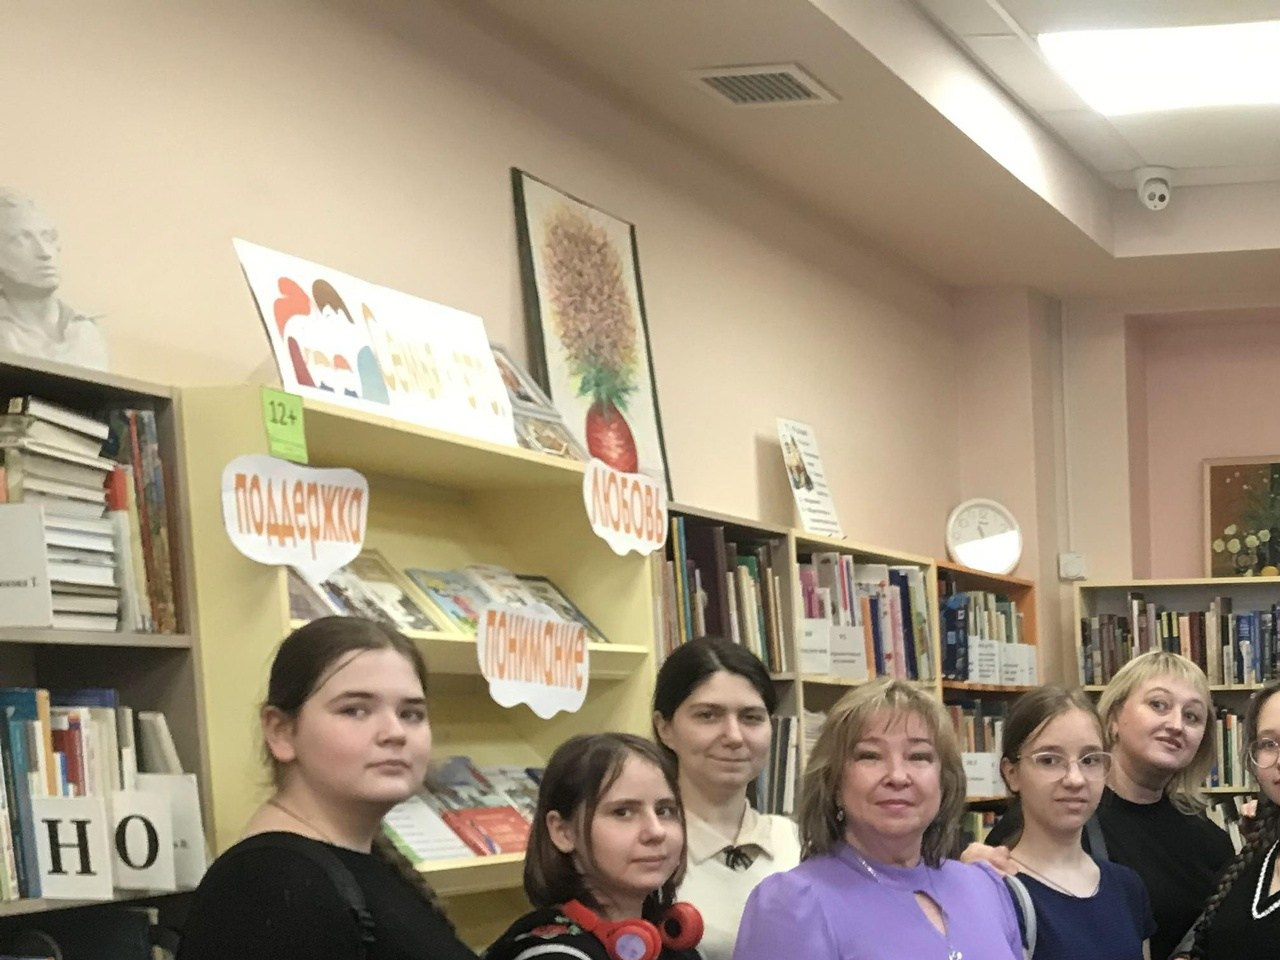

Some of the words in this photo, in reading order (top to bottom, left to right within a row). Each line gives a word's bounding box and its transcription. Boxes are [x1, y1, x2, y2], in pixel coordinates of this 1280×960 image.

[269, 400, 297, 426] 12+
[234, 473, 362, 560] поддержка
[486, 610, 585, 691] понимание
